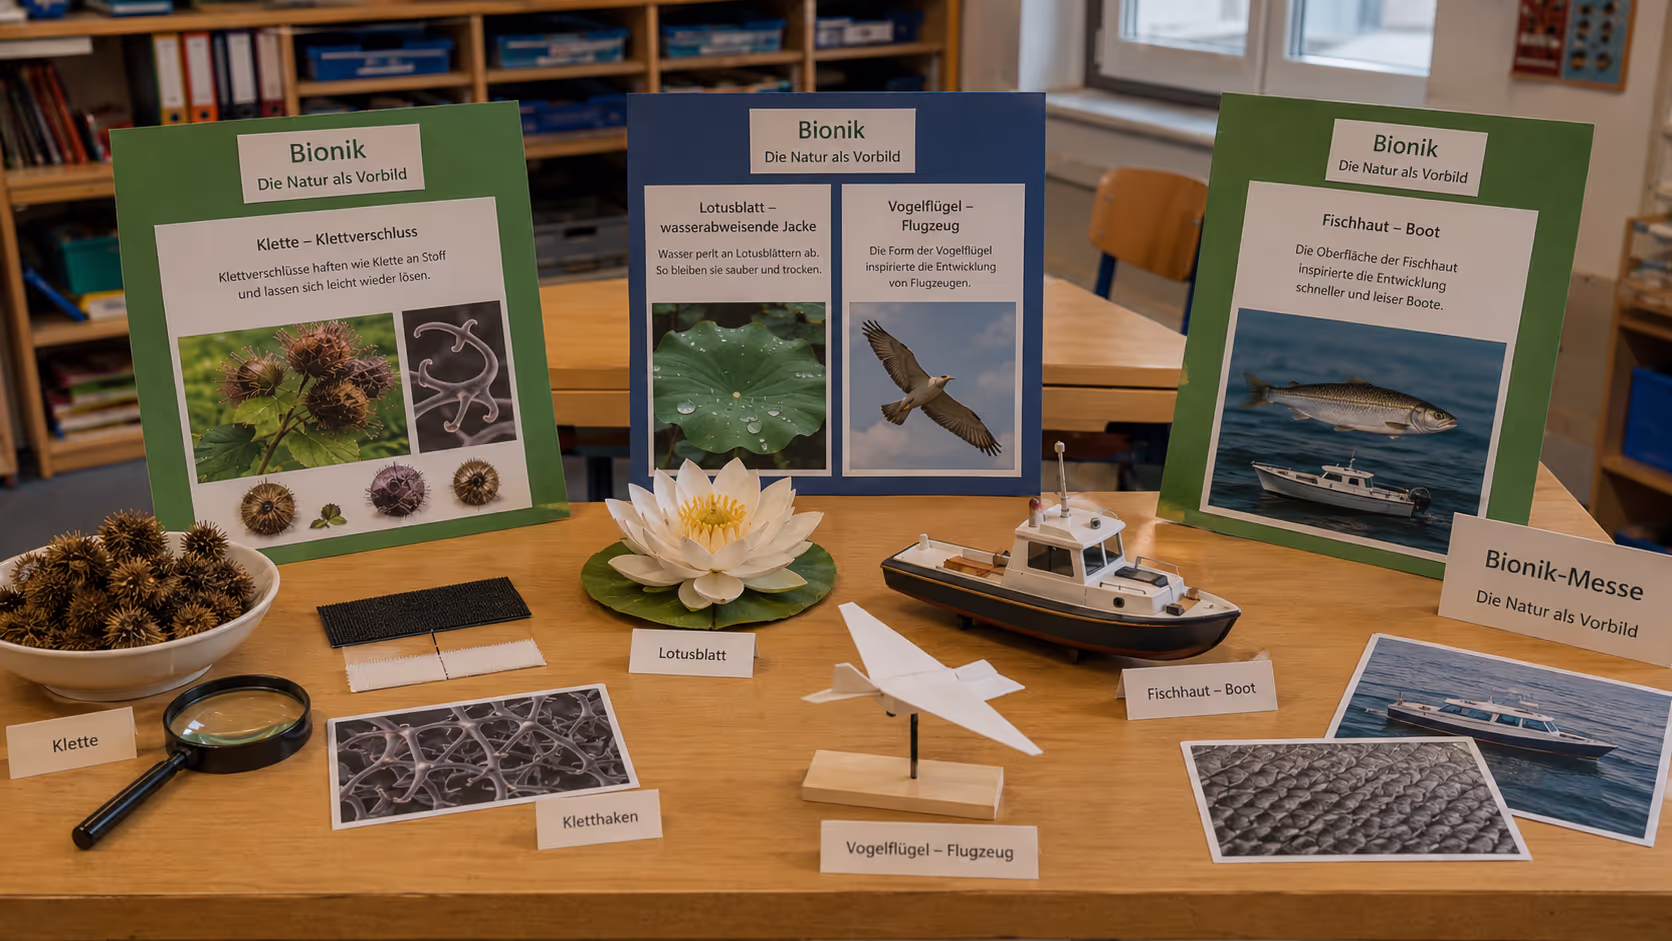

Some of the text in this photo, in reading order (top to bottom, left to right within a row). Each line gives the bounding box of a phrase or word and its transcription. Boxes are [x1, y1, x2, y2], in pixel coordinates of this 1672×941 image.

[799, 120, 865, 139] Bionik
[290, 139, 367, 163] Bionik
[1374, 135, 1438, 157] Bionik
[765, 151, 900, 162] Die Natur als Vorbild
[258, 167, 407, 190] Die Natur als Vorbild
[1339, 160, 1468, 183] Die Natur als Vorbild
[700, 201, 764, 213] Lotusblatt
[888, 200, 961, 215] Vogelflügel
[660, 220, 816, 233] wasserabweisende Jacke
[902, 219, 959, 234] Flugzeug
[1323, 214, 1389, 232] Fischhaut
[1406, 223, 1440, 238] Boot
[257, 238, 299, 251] Klette
[316, 227, 417, 245] Klettverschluss
[658, 250, 693, 259] Wasser
[696, 249, 718, 260] perlt
[736, 248, 801, 258] Lotusblättern
[804, 248, 819, 257] ab.
[870, 246, 992, 257] Die Form der Vogelflügel
[1296, 244, 1457, 273] Die Oberfläche der Fischhaut
[219, 266, 309, 282] Klettverschlüsse
[313, 261, 348, 273] haften
[351, 259, 369, 268] wie
[373, 257, 403, 267] Klette
[422, 250, 446, 262] Stoff
[656, 265, 821, 275] So bleiben sie sauber und trocken.
[866, 262, 996, 273] inspirierte die Entwicklung
[239, 272, 430, 299] und lassen sich leicht wieder lösen.
[911, 278, 970, 289] Flugzeugen.
[1299, 263, 1446, 293] inspirierte die Entwicklung
[1296, 283, 1443, 310] schneller und leiser Boote.
[1486, 550, 1643, 600] Bionik-Messe
[1477, 590, 1638, 638] Die Natur als Vorbild
[659, 647, 726, 661] Lotusblatt
[1148, 686, 1210, 700] Fischhaut
[1225, 683, 1256, 695] Boot
[53, 736, 98, 752] Klette
[563, 812, 638, 828] Kletthaken
[847, 841, 929, 859] Vogelflügel
[948, 844, 1013, 862] Flugzeug
